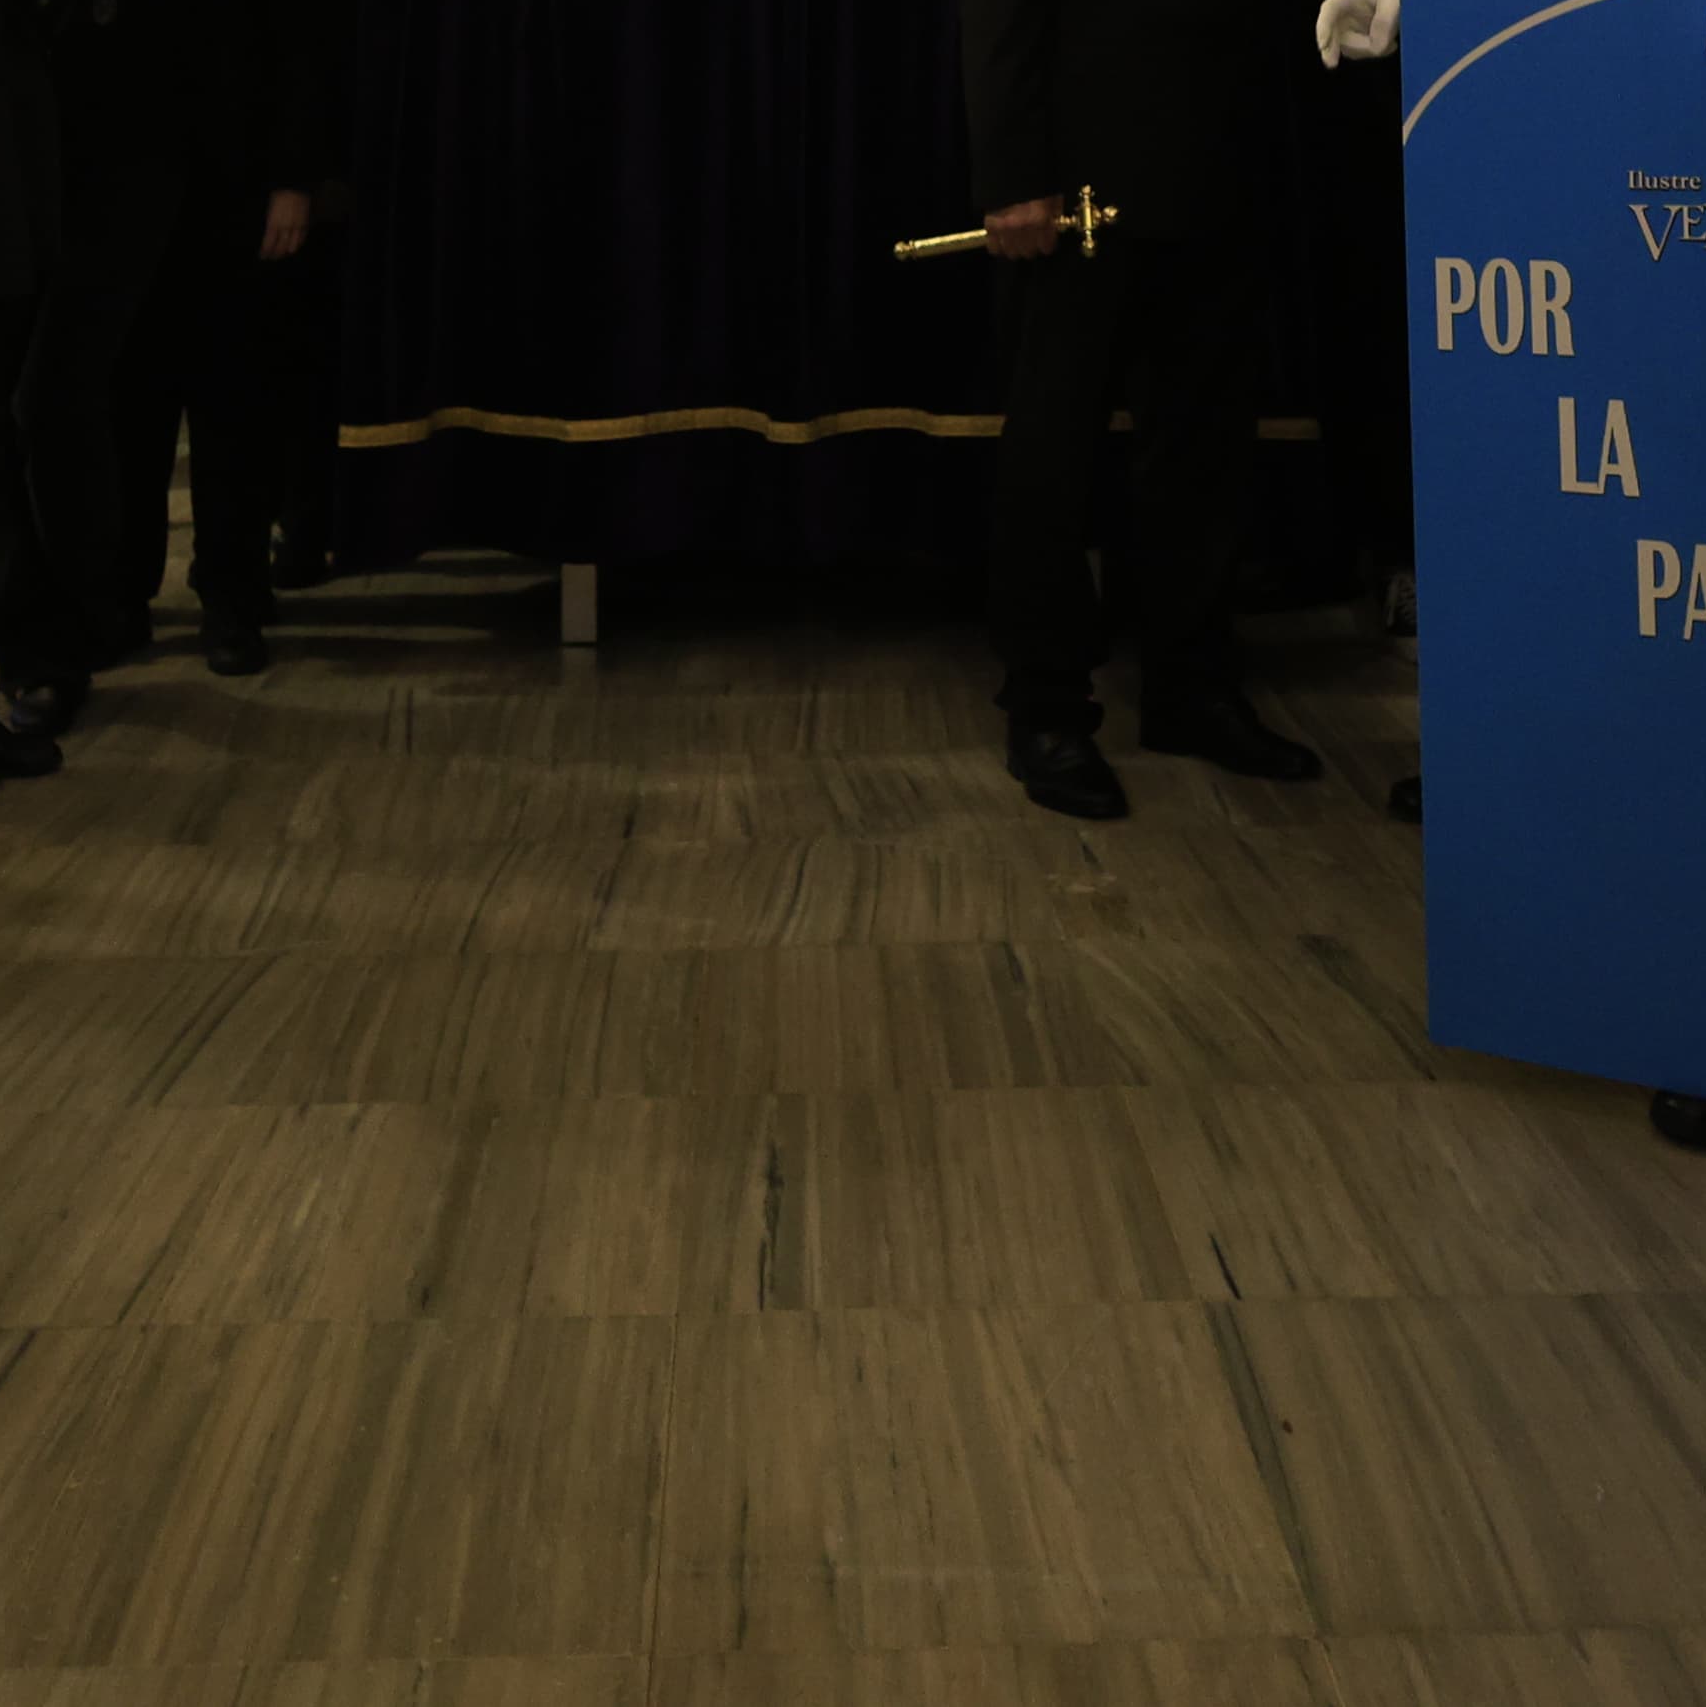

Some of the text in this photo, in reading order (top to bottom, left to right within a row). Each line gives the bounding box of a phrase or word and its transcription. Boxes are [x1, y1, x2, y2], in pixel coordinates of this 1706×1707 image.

[1628, 169, 1702, 191] Ilustre
[1435, 257, 1574, 357] POR
[1558, 396, 1640, 497] LA
